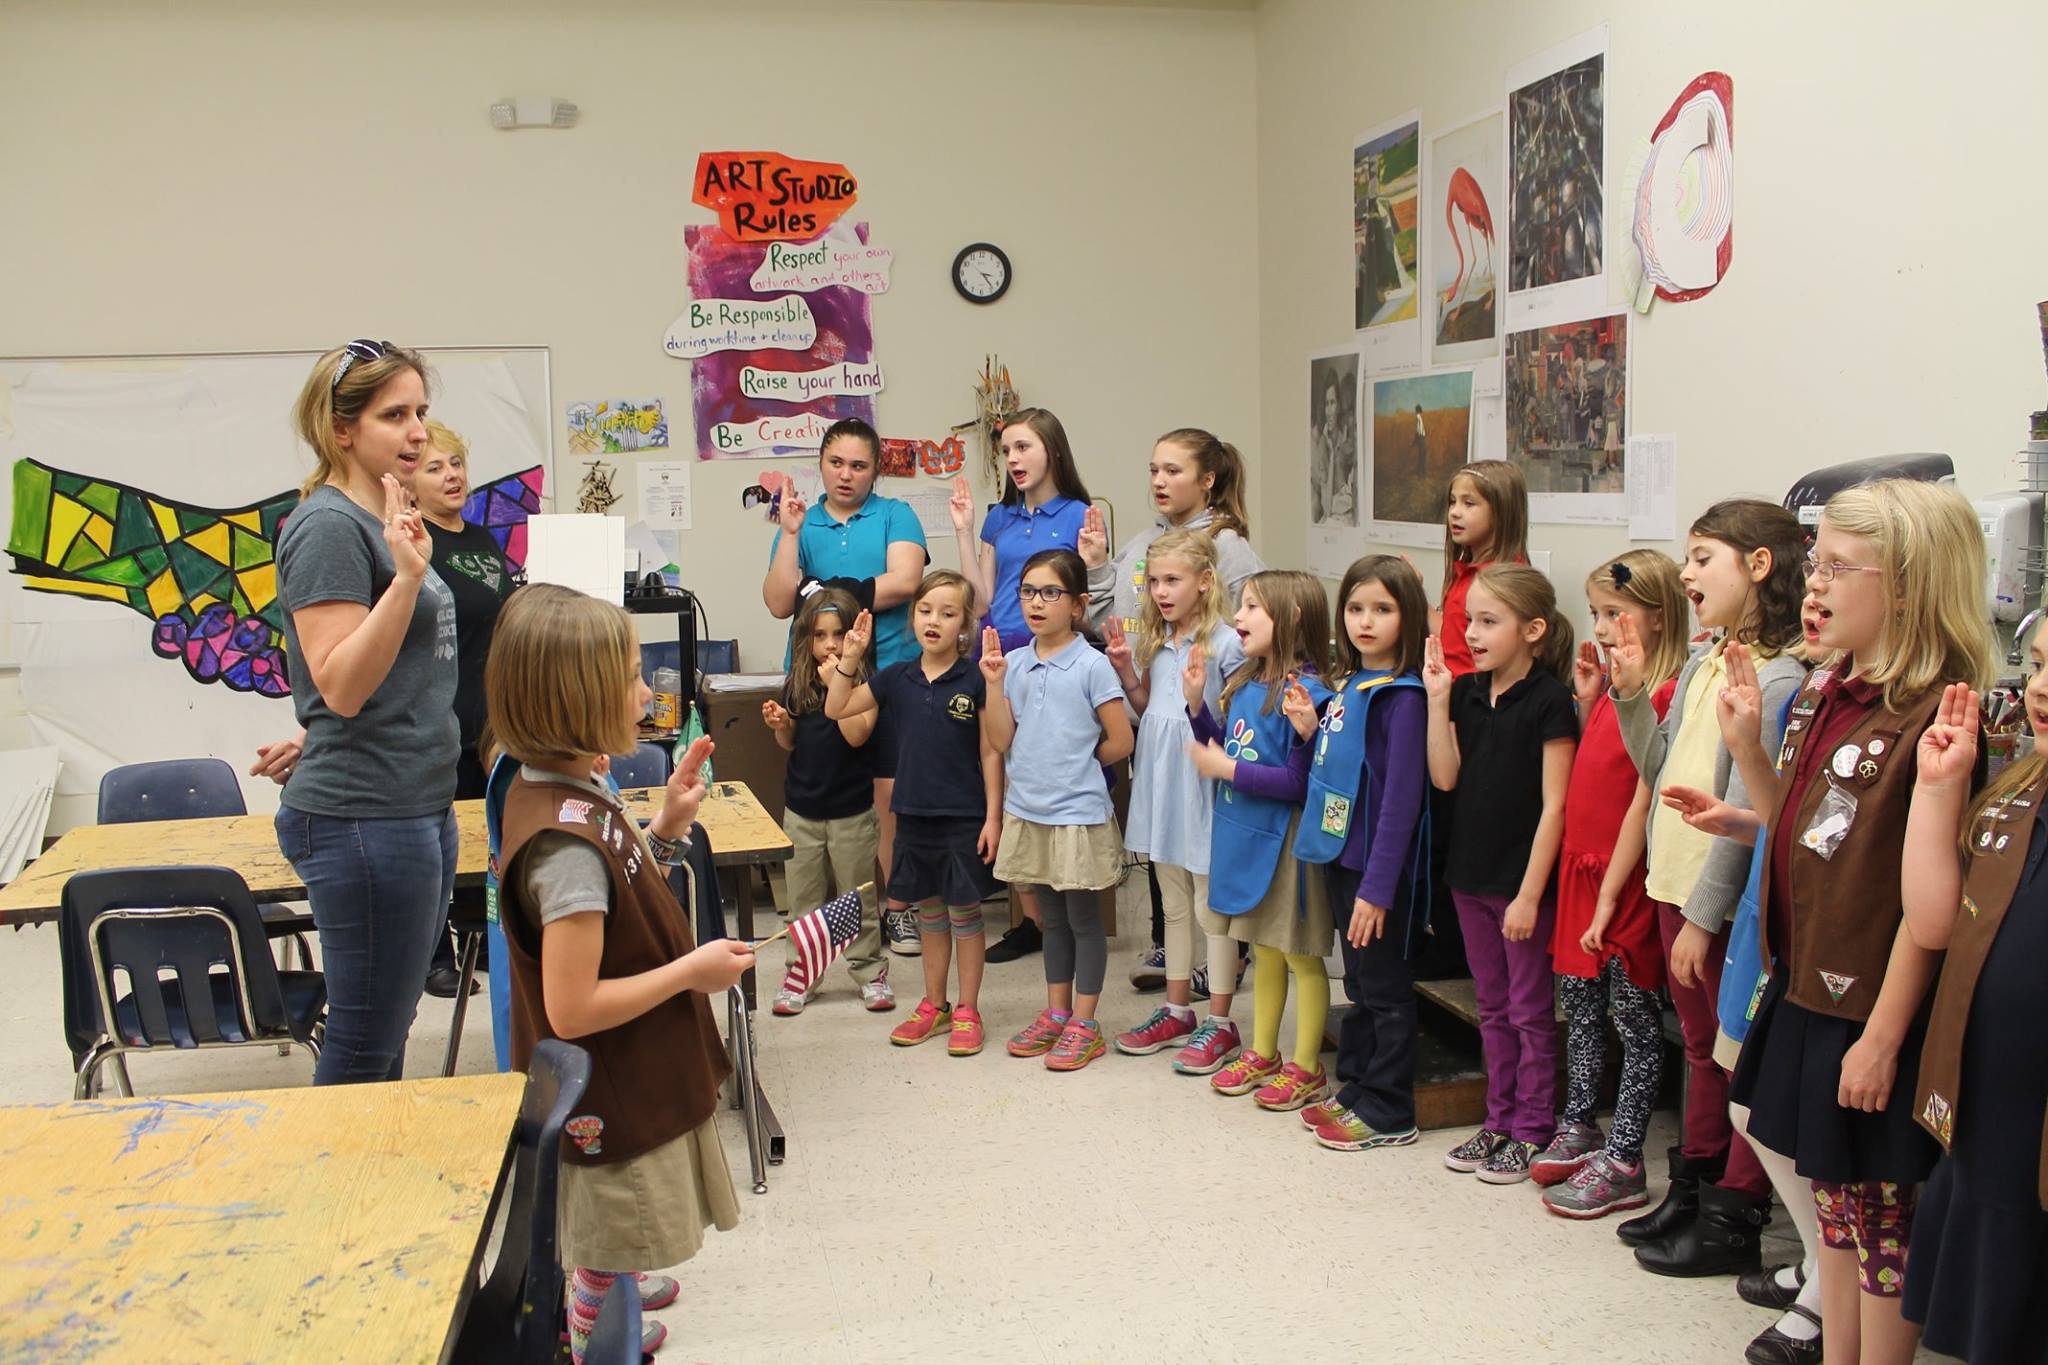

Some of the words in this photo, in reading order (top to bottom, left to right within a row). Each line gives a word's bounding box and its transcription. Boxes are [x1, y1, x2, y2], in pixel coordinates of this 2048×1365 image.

[703, 159, 770, 197] ART
[769, 167, 855, 206] STUDIO
[733, 201, 817, 237] Rules
[771, 240, 829, 272] Respect
[834, 252, 860, 271] your
[866, 249, 890, 258] own
[754, 275, 804, 290] artwork
[811, 272, 834, 284] and
[865, 281, 887, 291] art
[690, 303, 713, 329] Be
[719, 298, 809, 328] Responsible
[667, 335, 707, 354] during
[744, 368, 788, 394] Raise
[798, 375, 836, 399] your
[843, 364, 881, 389] hand
[717, 424, 744, 449] Be
[758, 415, 832, 441] Creativ
